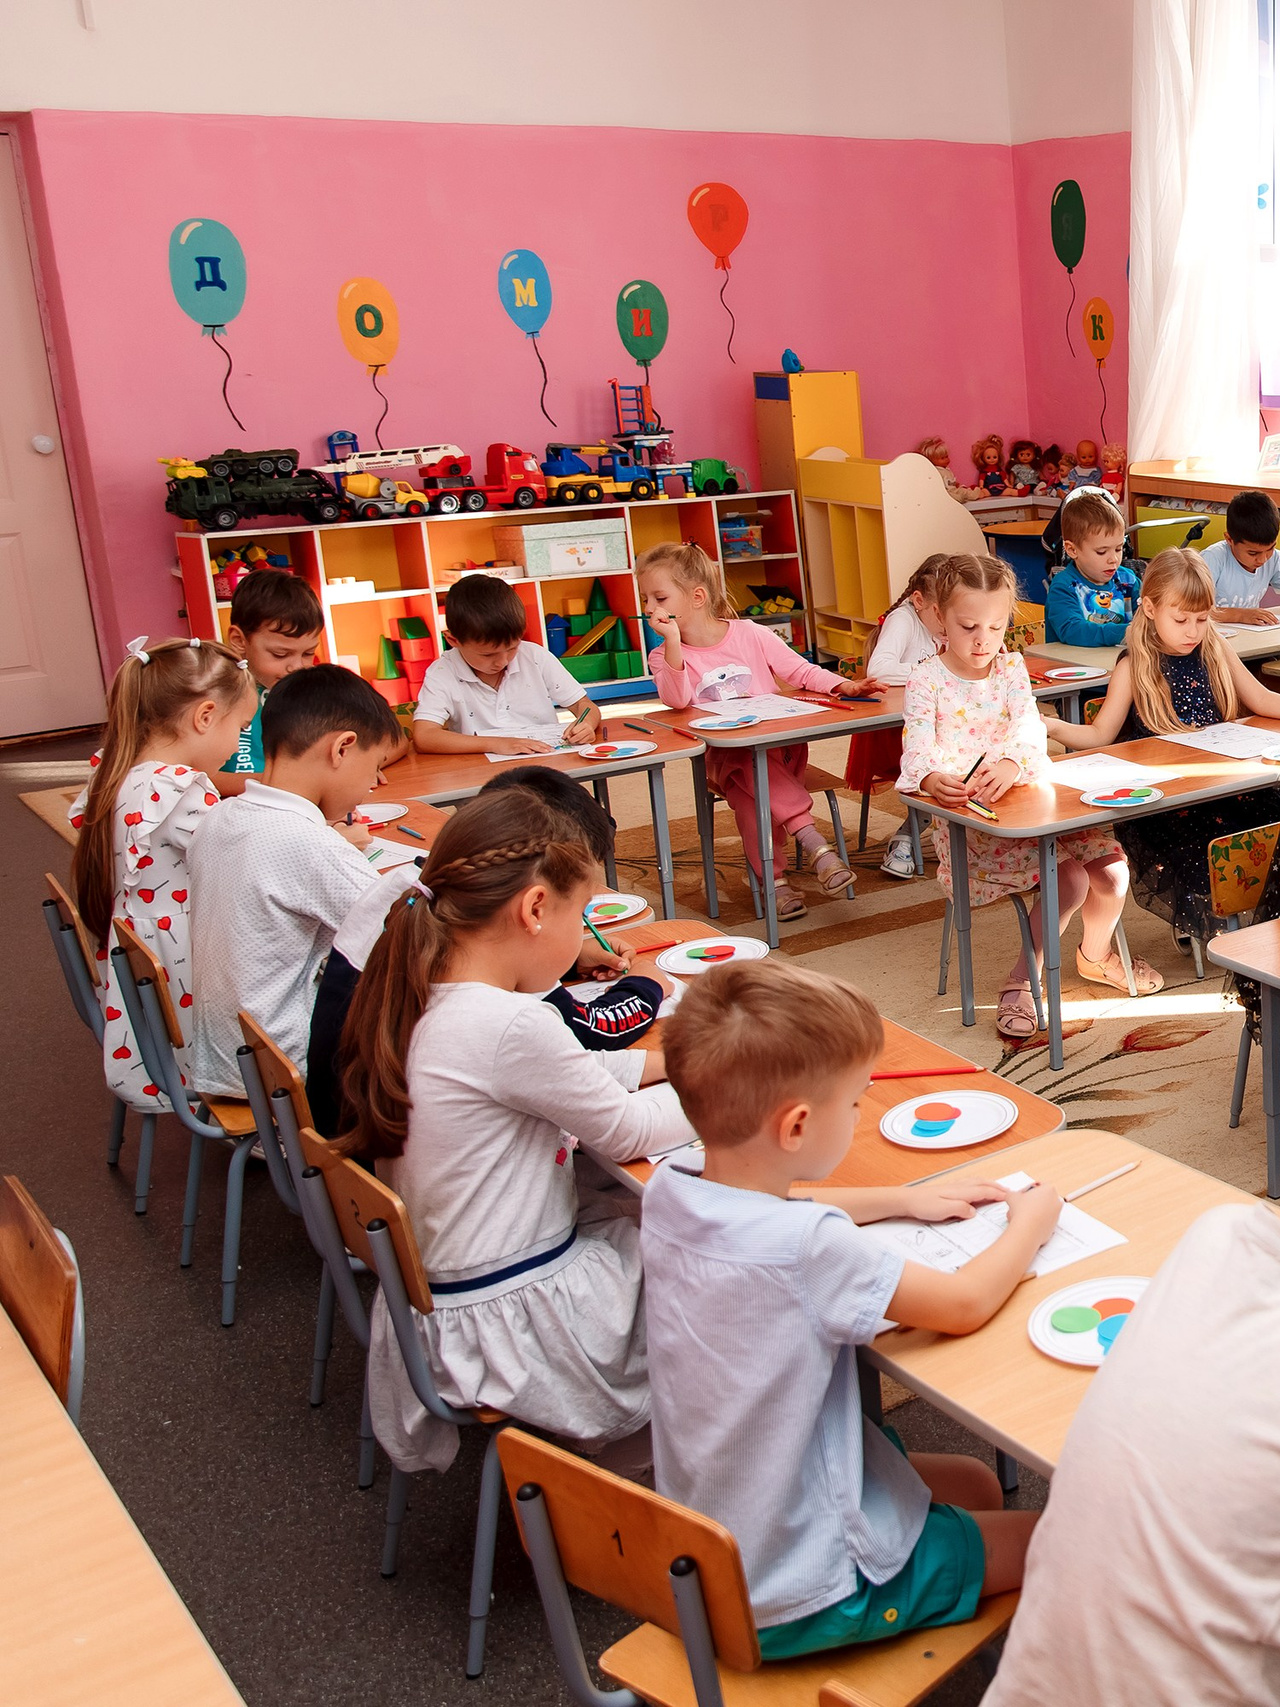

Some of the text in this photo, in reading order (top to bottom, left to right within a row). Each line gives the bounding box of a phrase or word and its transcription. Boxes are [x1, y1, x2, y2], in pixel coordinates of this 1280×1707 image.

[194, 256, 228, 292] Д
[512, 278, 539, 307] М
[355, 303, 384, 338] О
[630, 308, 654, 337] И
[1091, 314, 1105, 341] К
[611, 1528, 625, 1557] 1
